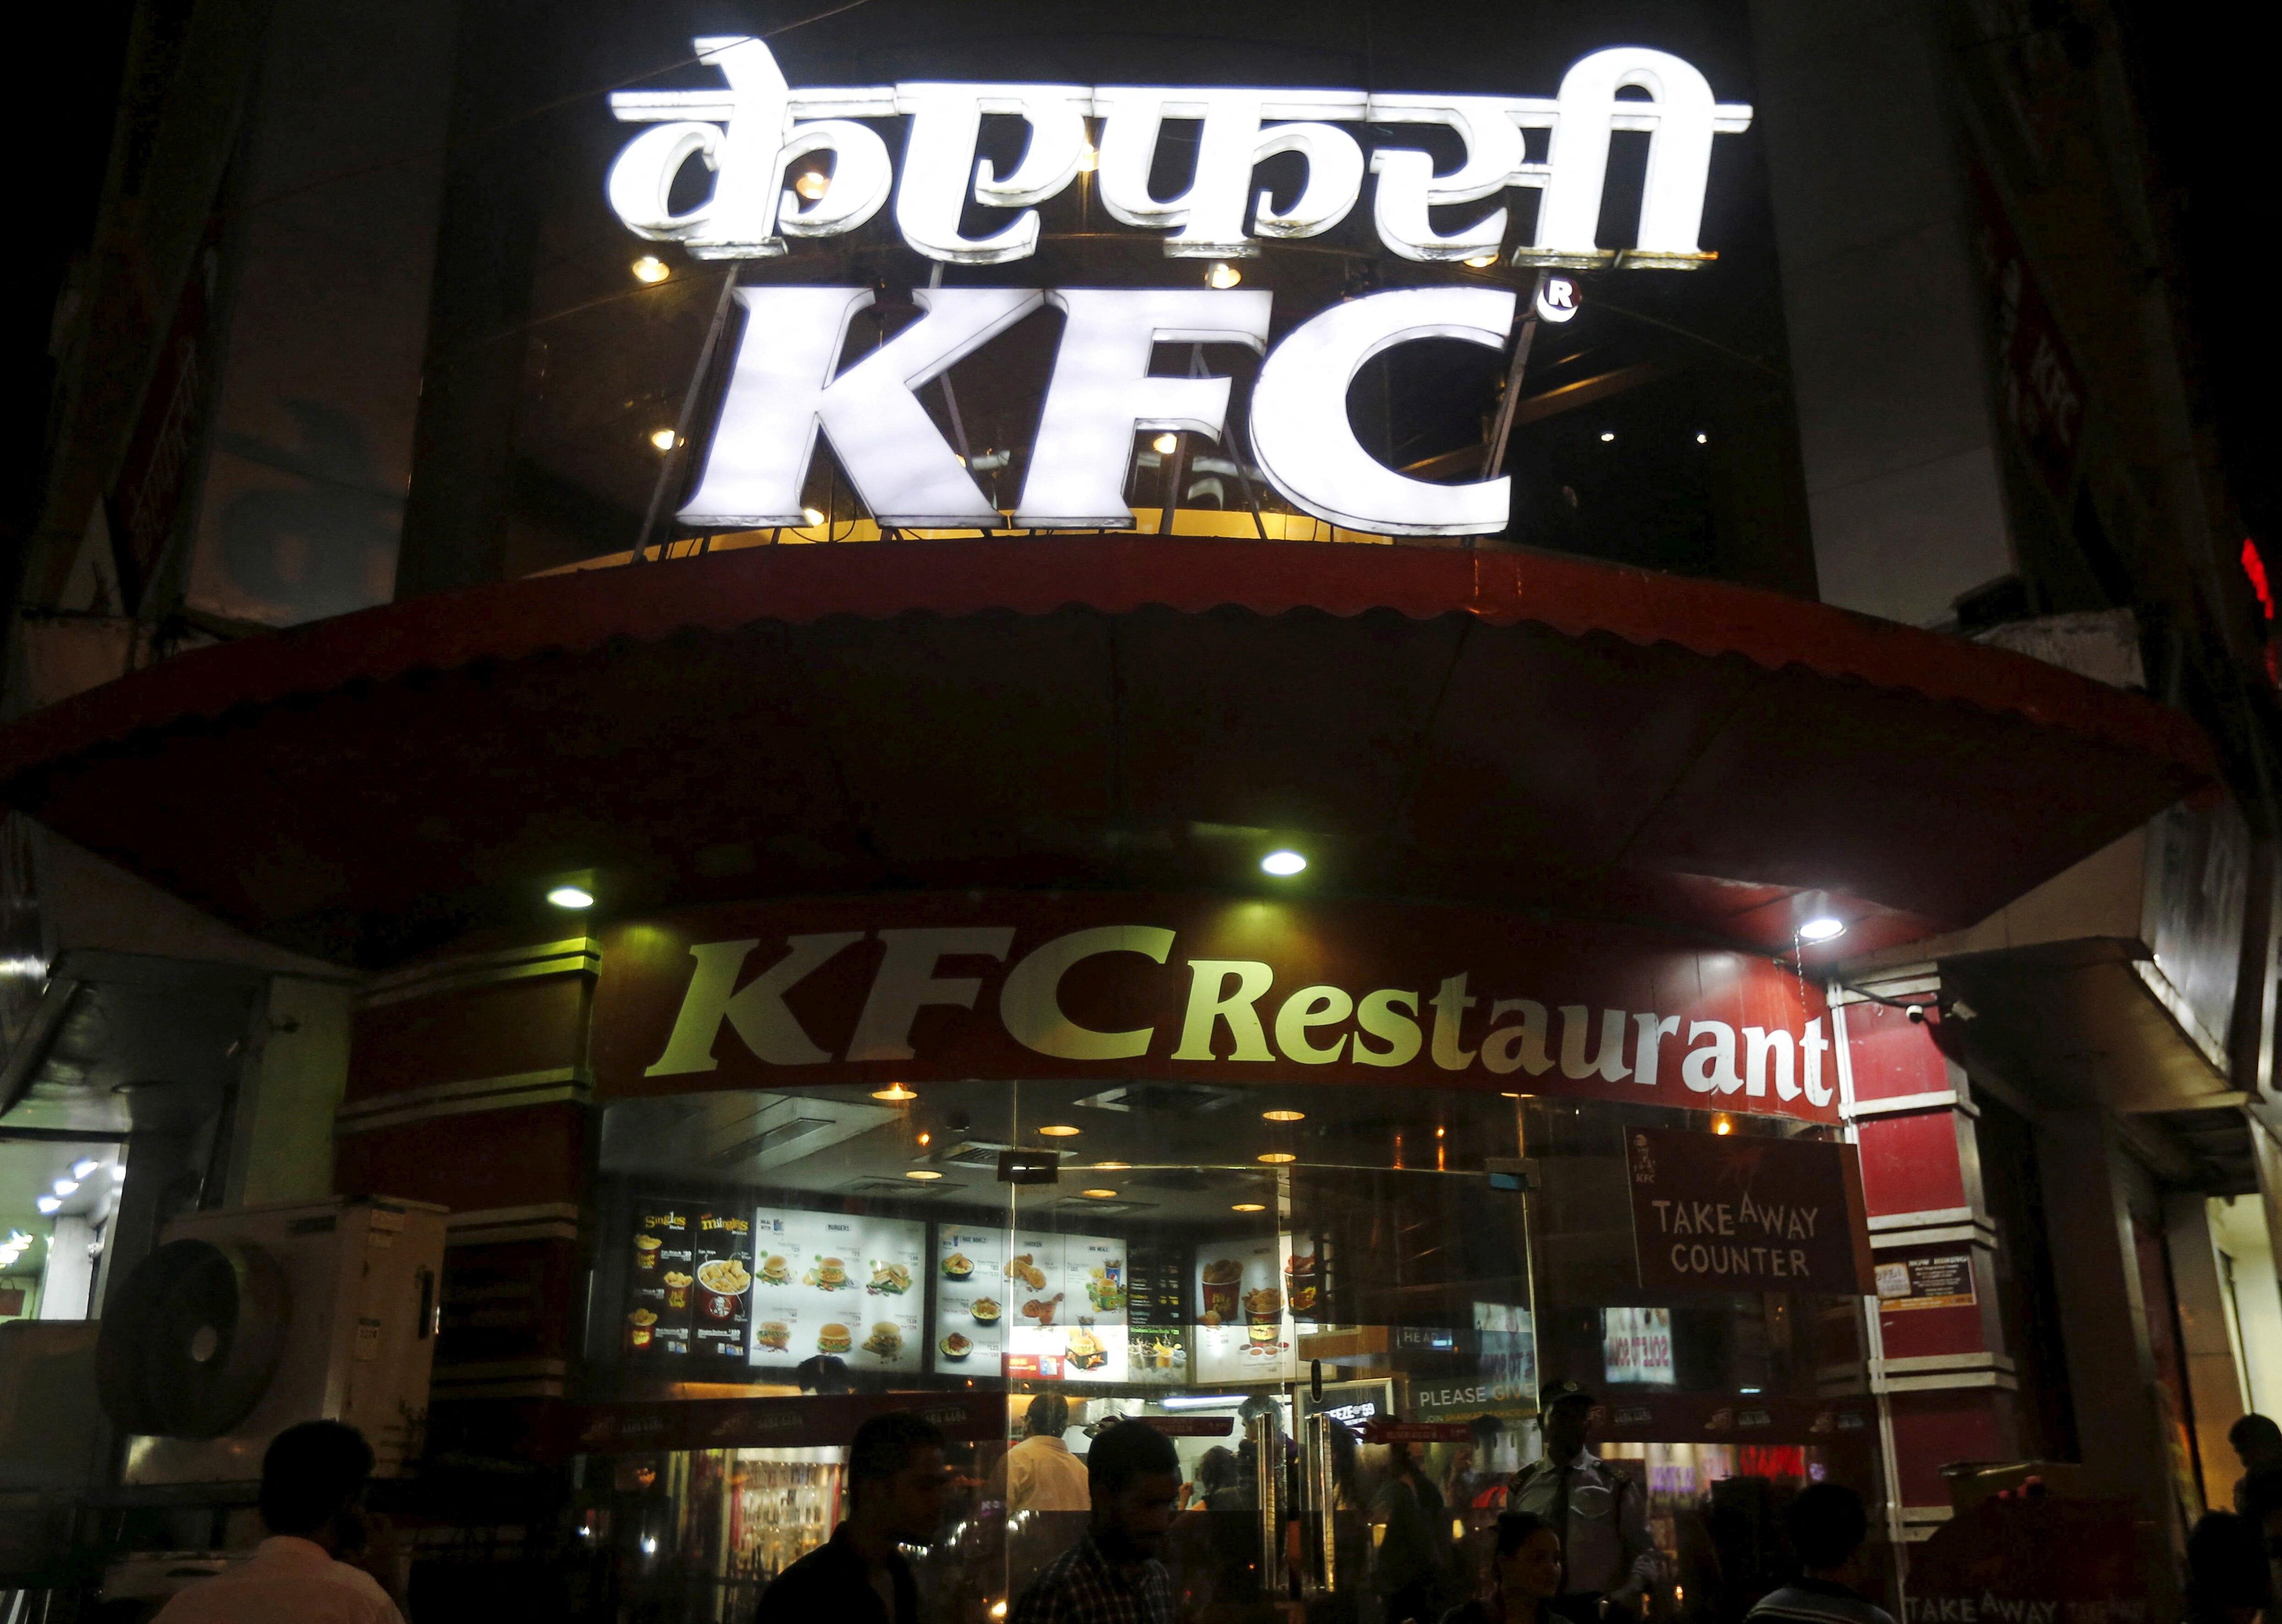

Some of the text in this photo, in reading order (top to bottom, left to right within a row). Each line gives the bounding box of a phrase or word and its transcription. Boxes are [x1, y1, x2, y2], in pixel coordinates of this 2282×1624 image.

[606, 36, 1752, 269] केएफसी
[676, 285, 1518, 537] KFC
[644, 924, 1833, 1107] KFC Restaurant
[1651, 1191, 1818, 1239] TAKE AWAY
[1671, 1243, 1810, 1276] COUNTER
[1420, 1383, 1535, 1407] PLEASE GIVE
[1905, 1597, 1977, 1623] TAKE
[1980, 1590, 2057, 1624] AWAY
